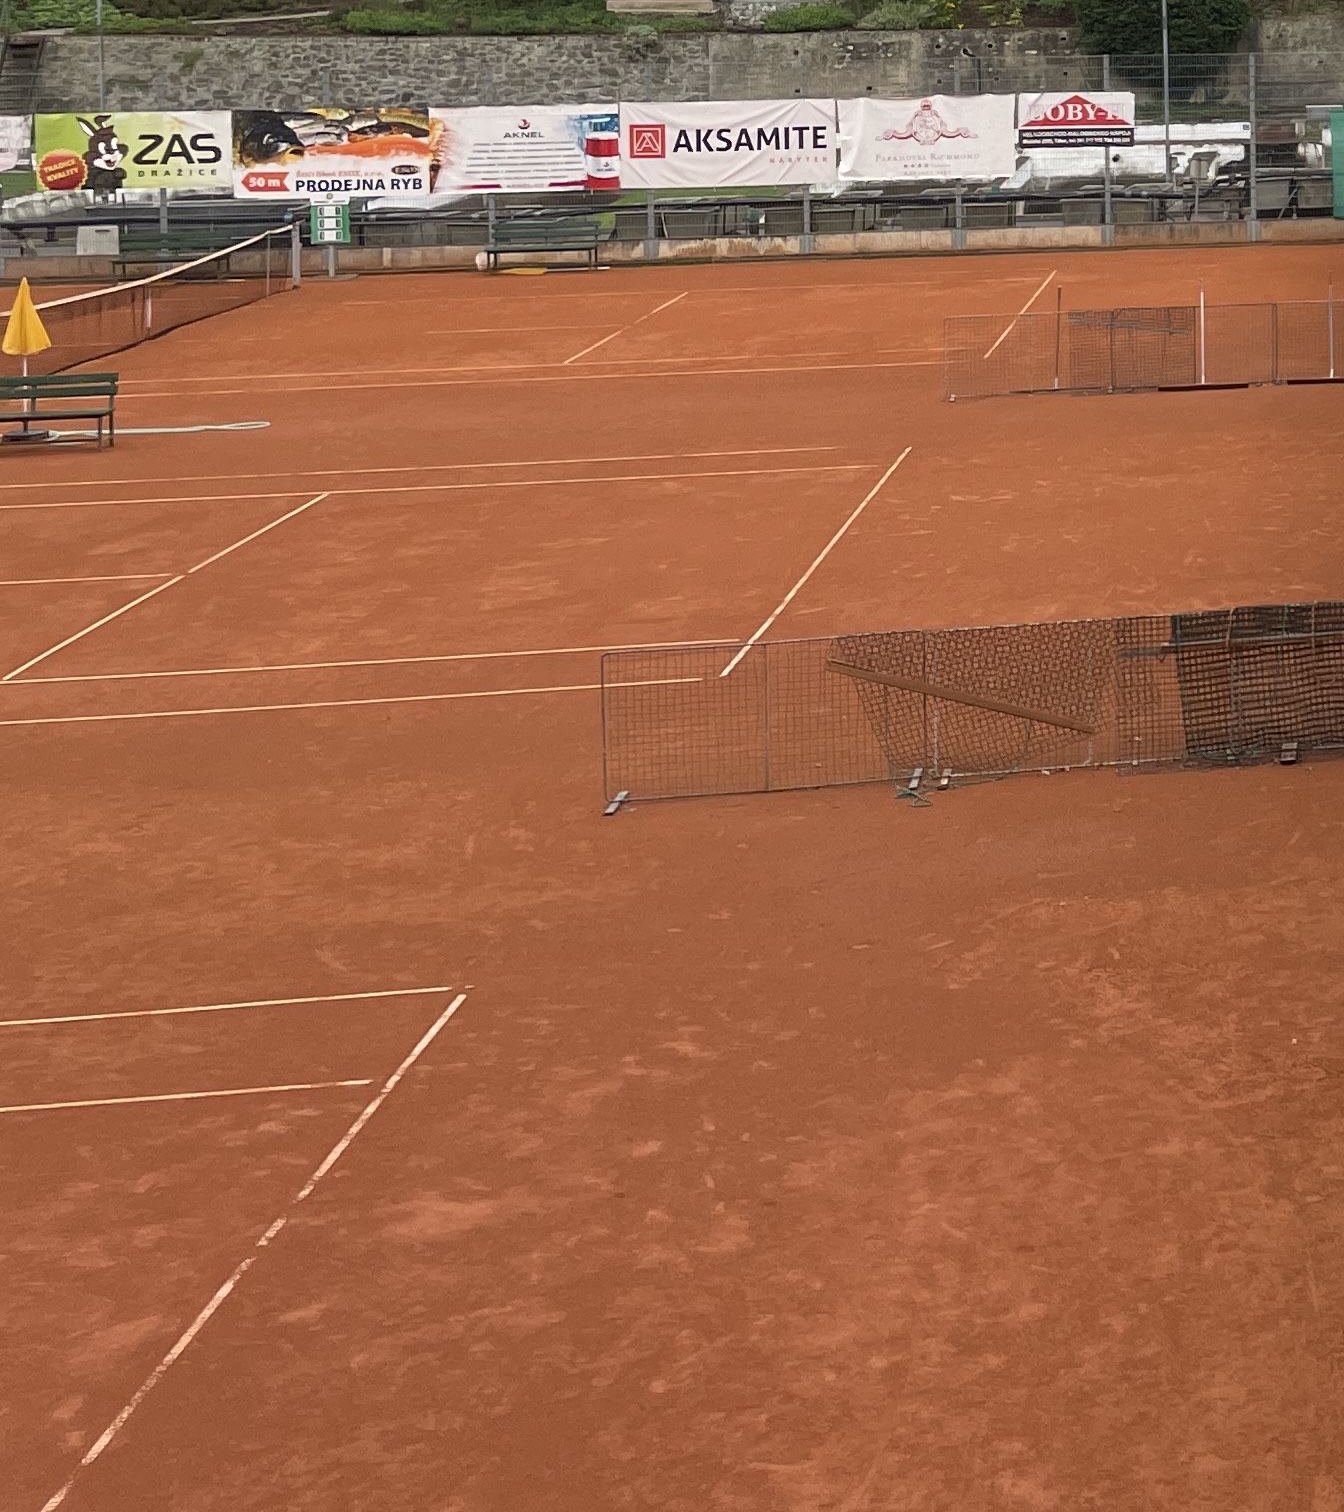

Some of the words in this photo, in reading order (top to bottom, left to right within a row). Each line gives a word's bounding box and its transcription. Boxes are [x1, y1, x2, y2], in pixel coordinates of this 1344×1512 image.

[503, 131, 545, 139] AKNEL
[672, 126, 828, 153] AKSAMITE
[132, 133, 222, 165] ZAS
[138, 168, 217, 178] DRAŽICE
[249, 178, 266, 188] 50
[269, 179, 280, 188] m
[295, 178, 386, 192] PRODEJNA
[391, 177, 422, 190] RYB
